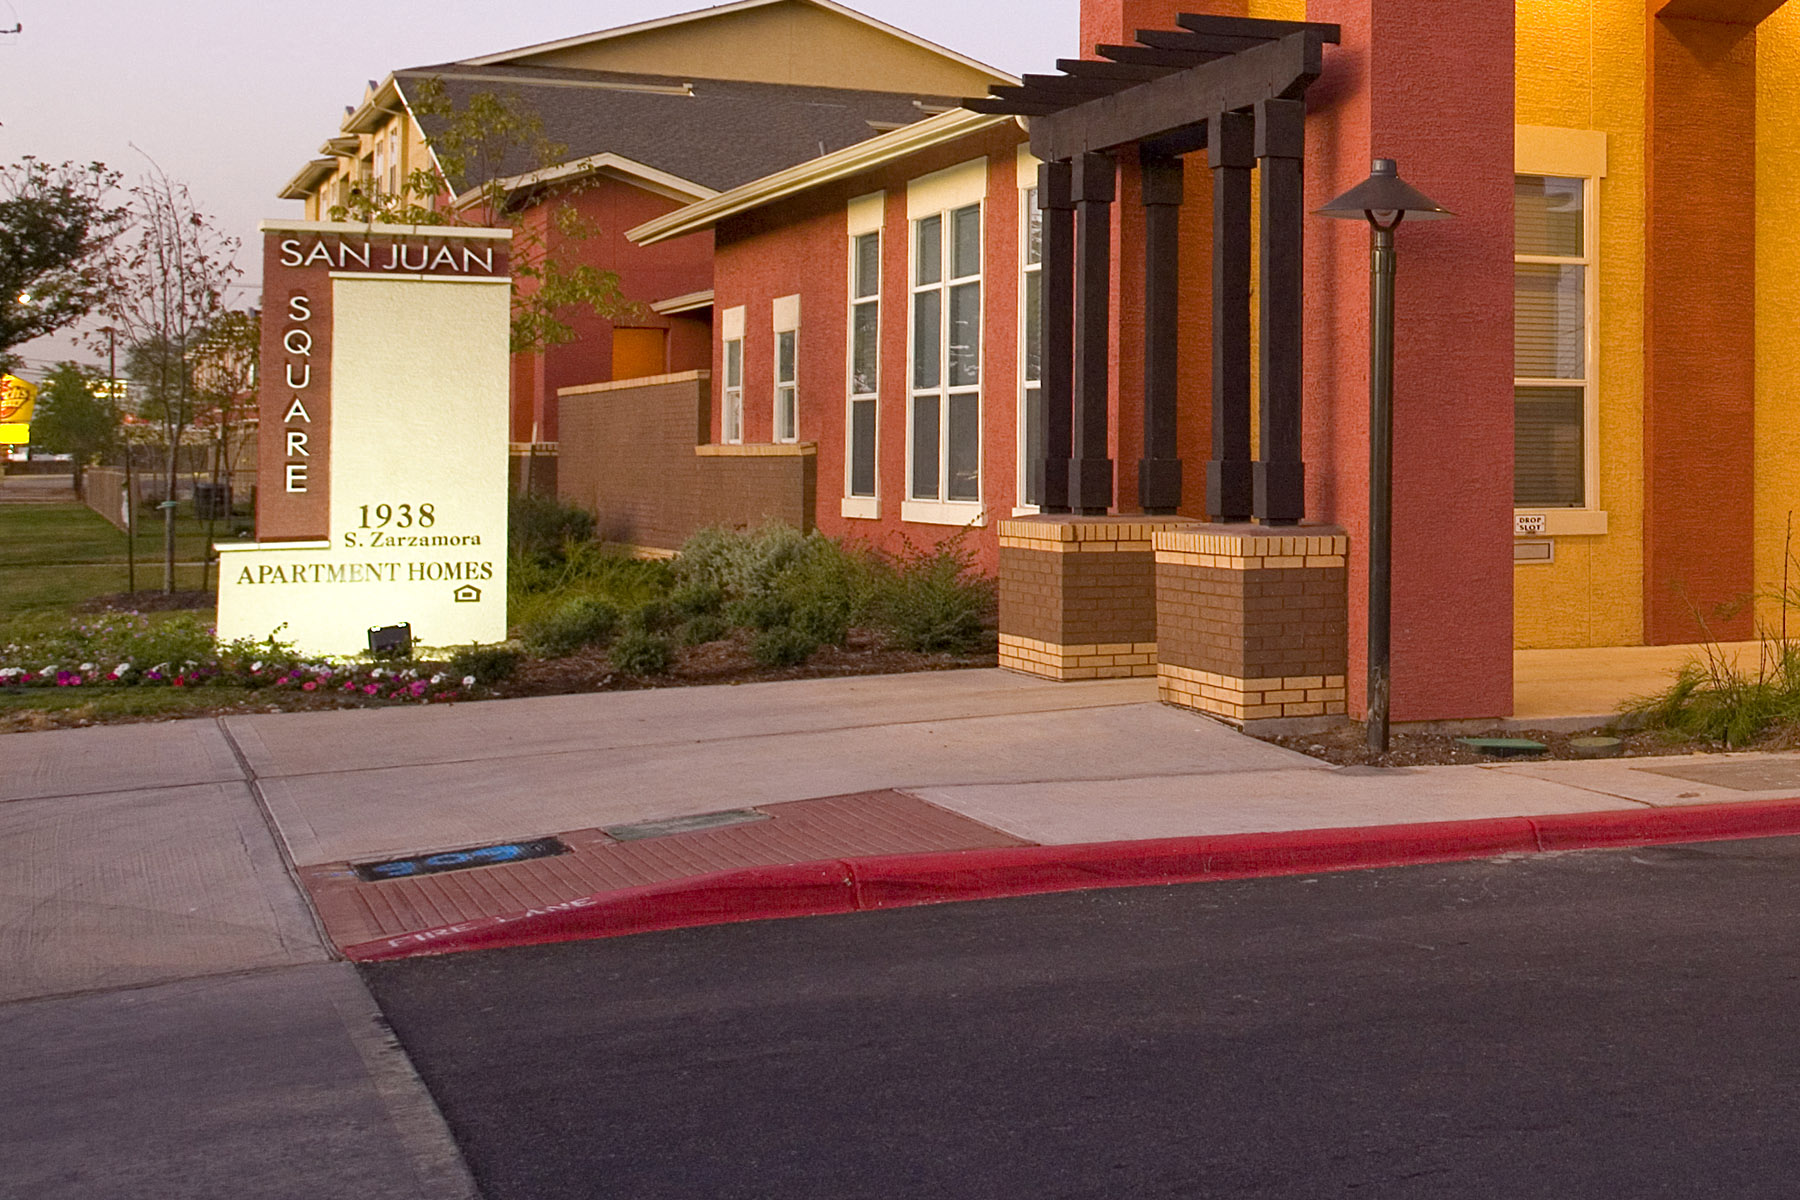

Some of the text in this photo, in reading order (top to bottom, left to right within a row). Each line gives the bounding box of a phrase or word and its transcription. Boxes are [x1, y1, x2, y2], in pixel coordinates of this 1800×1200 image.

[280, 240, 493, 273] SAN JUAN
[283, 295, 313, 493] SQUARE
[358, 503, 435, 529] 1938
[344, 531, 482, 548] S. Zarzamora
[236, 561, 493, 585] APARTMENT HOMES
[387, 896, 598, 947] FIRE LANE
